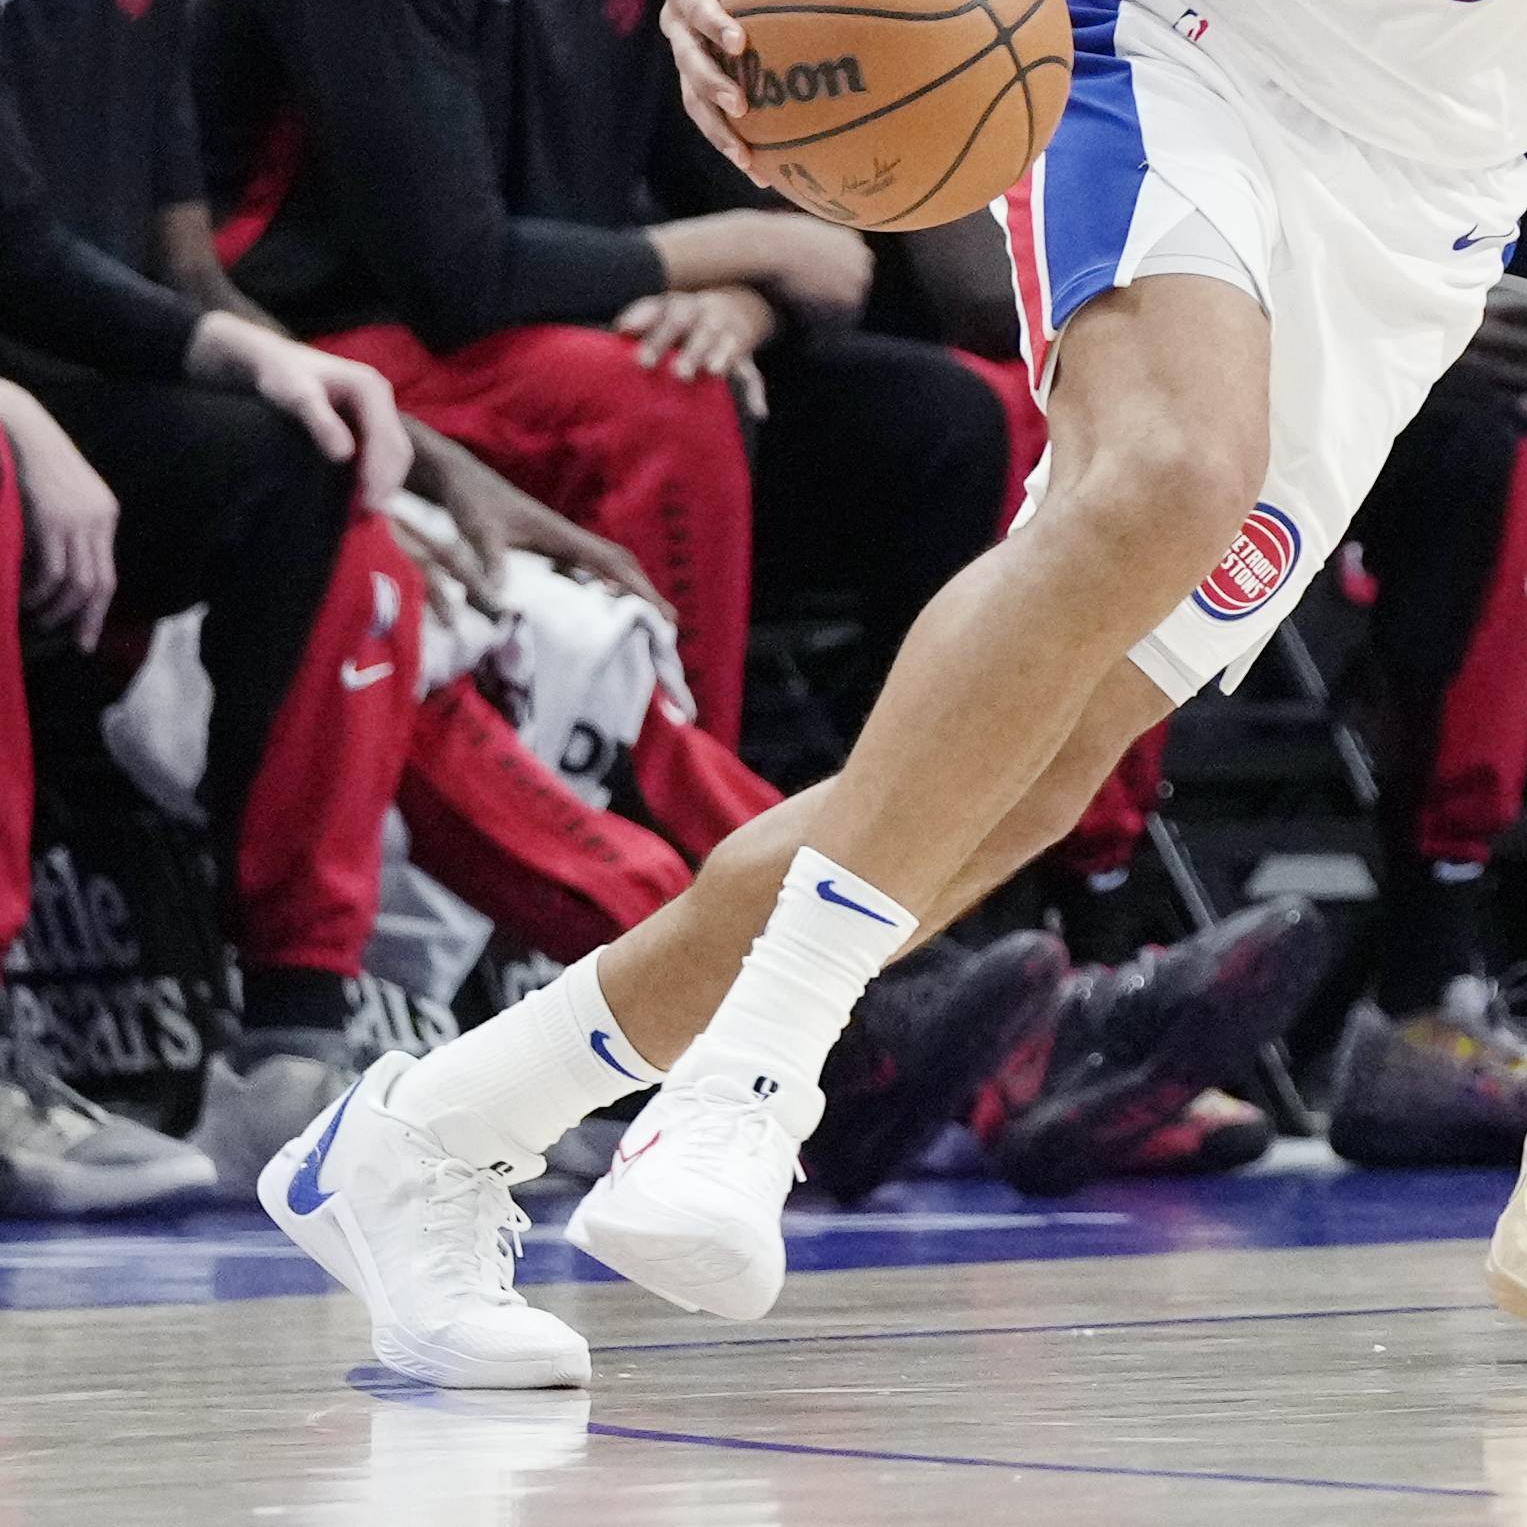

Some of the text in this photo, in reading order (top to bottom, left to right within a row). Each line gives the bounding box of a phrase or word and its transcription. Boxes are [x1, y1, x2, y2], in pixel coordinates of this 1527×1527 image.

[740, 48, 867, 110] lson
[1219, 548, 1265, 599] STONS
[1230, 529, 1279, 584] ETROIT
